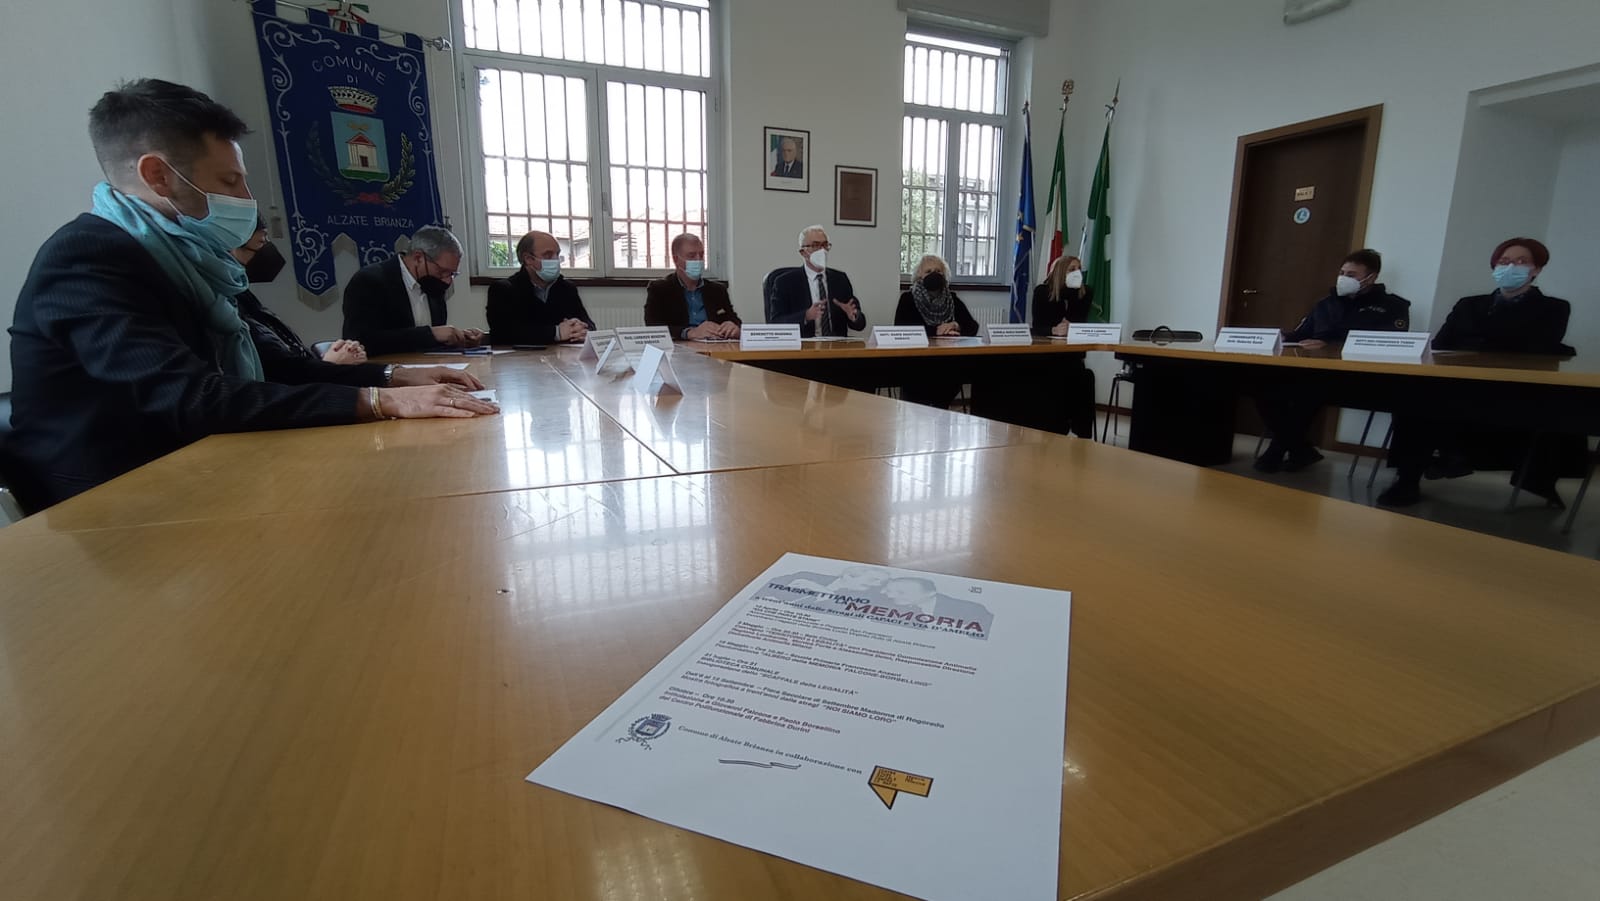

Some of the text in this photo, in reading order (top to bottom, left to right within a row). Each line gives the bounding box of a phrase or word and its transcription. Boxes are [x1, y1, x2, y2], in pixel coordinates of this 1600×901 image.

[312, 56, 386, 85] COMUNE
[346, 75, 358, 84] DI
[328, 216, 414, 228] ALZATE BRIANZA
[766, 583, 871, 604] TRASMETTIAMO
[761, 597, 804, 606] trent'anni
[866, 615, 902, 623] CAPACI
[931, 625, 984, 637] D'AMELIO
[844, 602, 984, 632] MEMORIA
[676, 725, 709, 736] Comune
[717, 735, 743, 745] Alzate
[742, 741, 775, 753] Brianza
[784, 751, 845, 770] collaborazione
